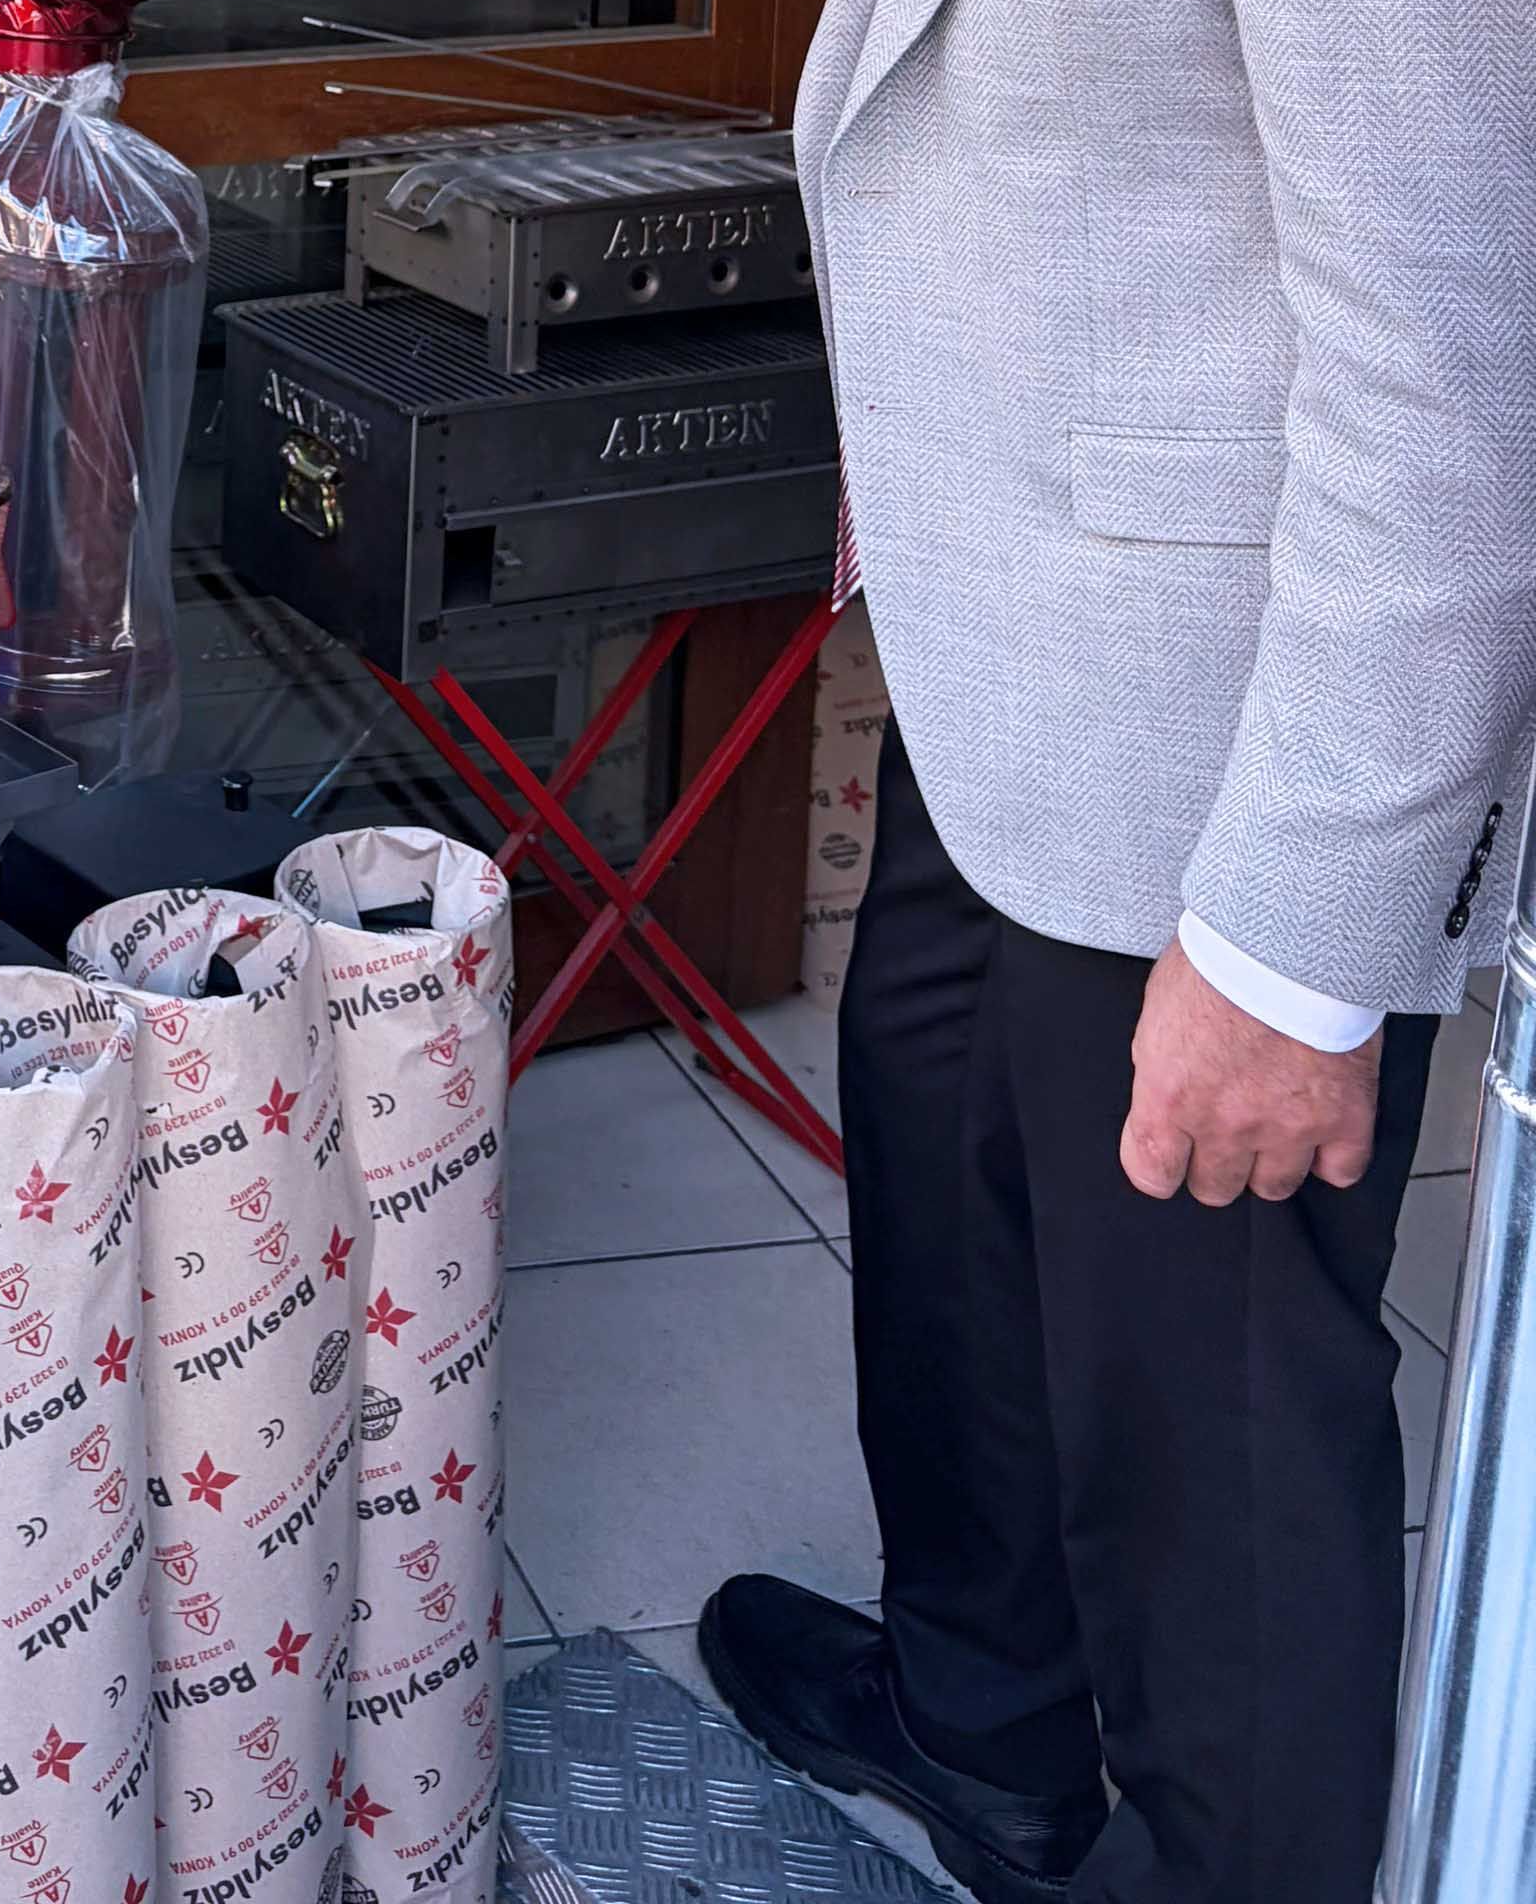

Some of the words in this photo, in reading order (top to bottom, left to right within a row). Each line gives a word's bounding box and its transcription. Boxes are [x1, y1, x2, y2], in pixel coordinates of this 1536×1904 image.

[603, 205, 775, 261] AKTEN
[263, 369, 371, 458] AKTEN
[599, 399, 775, 461] AKTEN
[148, 947, 168, 969] 239
[169, 937, 186, 952] 00
[185, 927, 201, 944] 91
[332, 967, 347, 981] 91
[348, 964, 364, 977] 00
[366, 958, 388, 972] 239
[367, 1093, 395, 1118] CE
[85, 1117, 109, 1150] CE
[147, 1122, 162, 1138] 00
[164, 1114, 188, 1132] 239
[435, 1133, 455, 1152] 239
[400, 1158, 416, 1171] 91
[418, 1147, 433, 1162] 00
[229, 1176, 268, 1206] Quality
[74, 1193, 113, 1236] KONYA
[249, 1198, 261, 1215] A
[175, 1252, 205, 1279] CE
[436, 1261, 461, 1289] CE
[1, 1284, 18, 1303] A
[249, 1285, 272, 1307] 239
[213, 1309, 230, 1328] 91
[230, 1301, 247, 1318] 00
[7, 1309, 44, 1335] Kalite
[174, 1274, 316, 1383] Besyıldız
[25, 1331, 41, 1349] A
[159, 1322, 208, 1347] KONYA
[417, 1331, 461, 1364] KONYA
[31, 1363, 57, 1389] 332)
[5, 1381, 31, 1403] 239
[69, 1424, 106, 1460] Quality
[258, 1418, 284, 1448] CE
[86, 1445, 100, 1464] A
[93, 1466, 124, 1498] Kalite
[108, 1488, 122, 1506] A
[243, 1491, 288, 1529] KONYA
[17, 1517, 48, 1548] CE
[92, 1540, 112, 1566] 239
[73, 1563, 90, 1582] 00
[172, 1560, 187, 1577] A
[18, 1520, 145, 1662] Besyıldız
[56, 1576, 73, 1595] 91
[1, 1593, 53, 1630] KONYA
[194, 1611, 208, 1627] A
[174, 1654, 197, 1670] 239
[393, 1657, 410, 1671] 00
[412, 1645, 434, 1664] 239
[377, 1663, 392, 1677] 91
[104, 1674, 127, 1707] CE
[256, 1737, 270, 1754] A
[91, 1748, 130, 1793] KONYA
[414, 1769, 441, 1794] CE
[275, 1776, 289, 1793] A
[184, 1787, 213, 1813] CE
[0, 1819, 42, 1846] Quality
[257, 1818, 279, 1840] 239
[20, 1840, 36, 1858] A
[221, 1845, 237, 1863] 91
[238, 1836, 255, 1853] 00
[394, 1835, 440, 1859] KONYA
[169, 1855, 216, 1875] KONYA
[27, 1865, 62, 1889] Kalite
[43, 1885, 60, 1904] A
